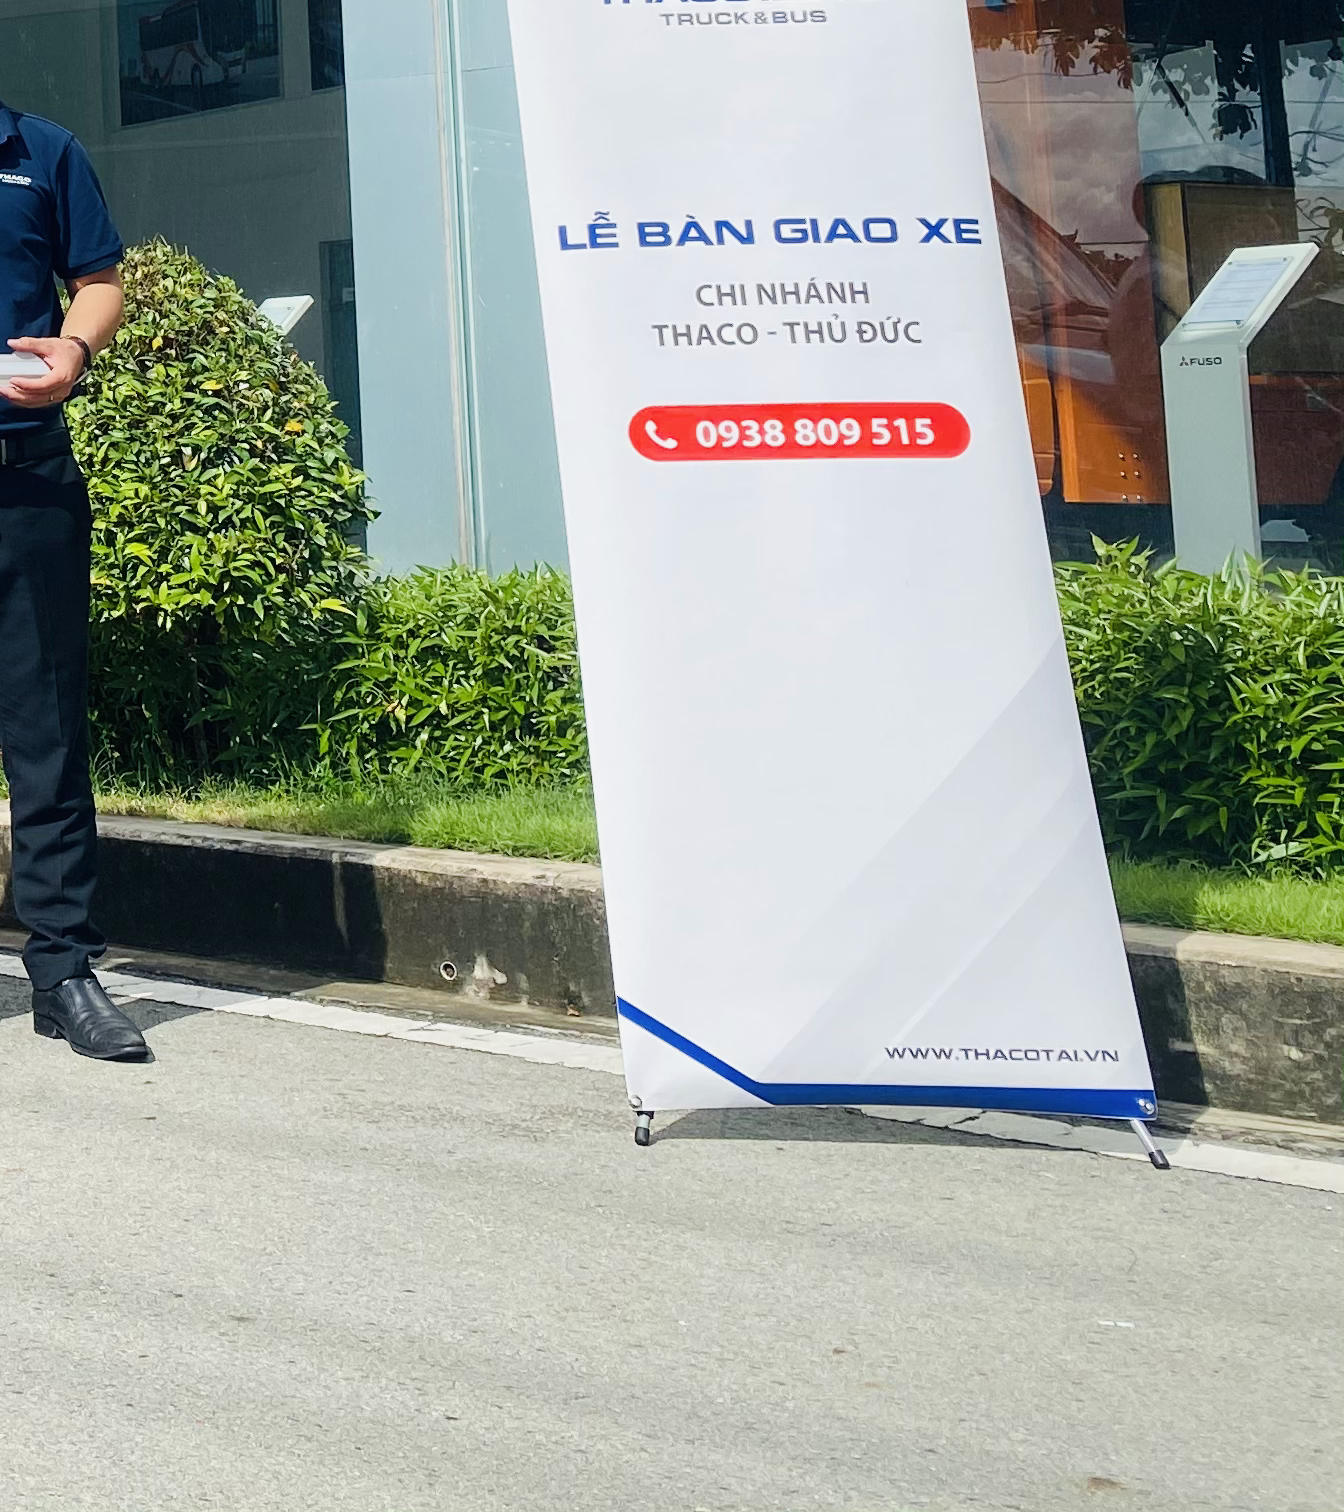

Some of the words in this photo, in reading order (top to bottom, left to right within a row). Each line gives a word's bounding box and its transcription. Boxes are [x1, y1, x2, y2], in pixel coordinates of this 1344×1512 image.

[558, 211, 619, 251] LỄ
[637, 214, 756, 248] BÀN
[773, 217, 898, 245] GIAO
[917, 217, 983, 245] XE
[695, 284, 747, 307] CHI
[756, 277, 870, 306] NHÁNH
[652, 322, 759, 347] THACO
[782, 313, 847, 344] THỦ
[856, 314, 923, 344] ĐỨC
[1189, 356, 1222, 367] FUSO
[695, 420, 783, 448] 0938
[794, 419, 861, 447] 809
[870, 417, 936, 446] 515
